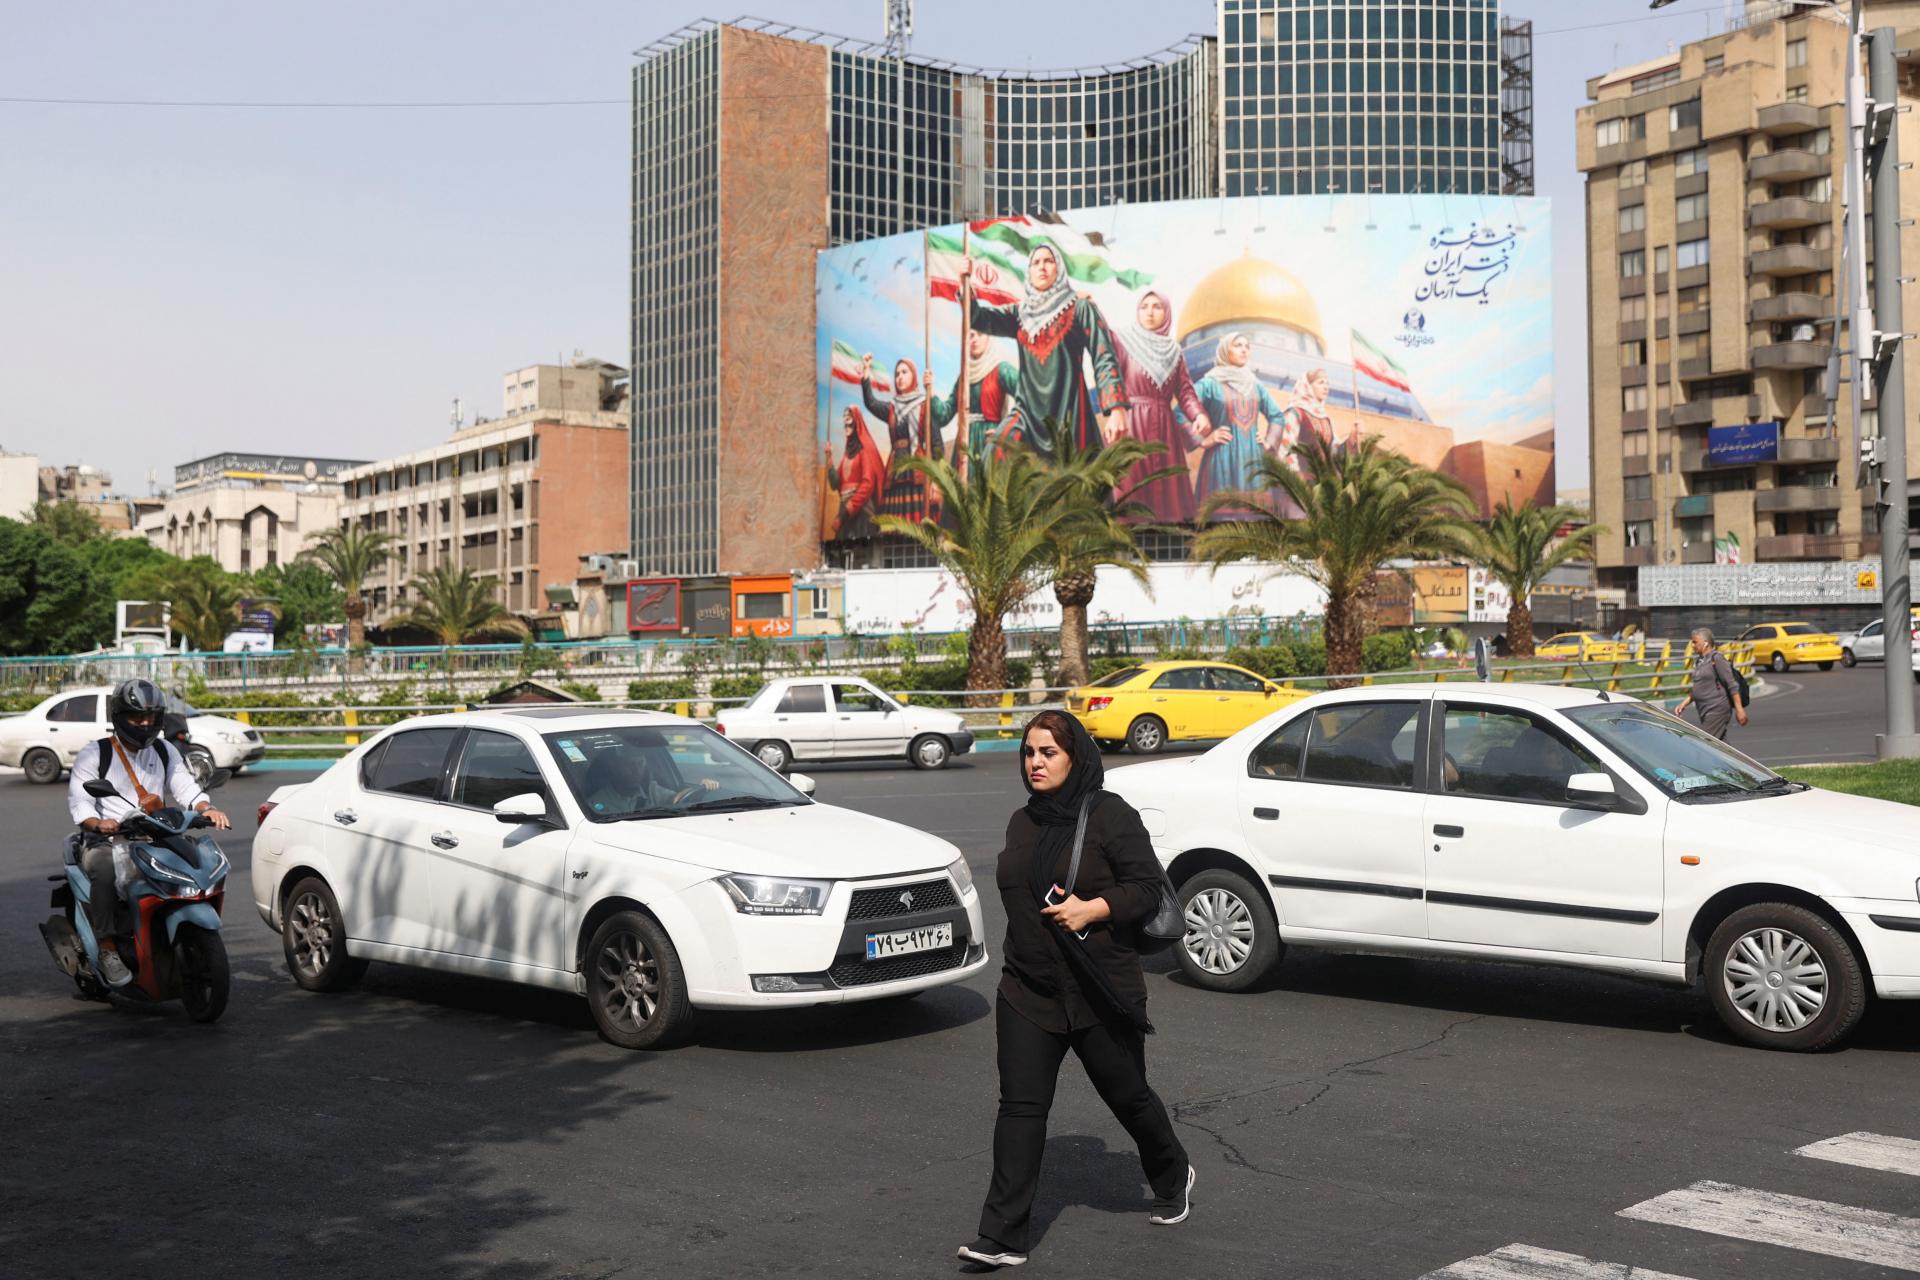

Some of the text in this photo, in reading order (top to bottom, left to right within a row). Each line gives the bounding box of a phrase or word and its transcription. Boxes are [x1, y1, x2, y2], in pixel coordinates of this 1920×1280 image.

[1430, 222, 1516, 250] دختر غزه
[1425, 248, 1509, 276] دختر ایران
[1415, 270, 1502, 304] یک آرمان
